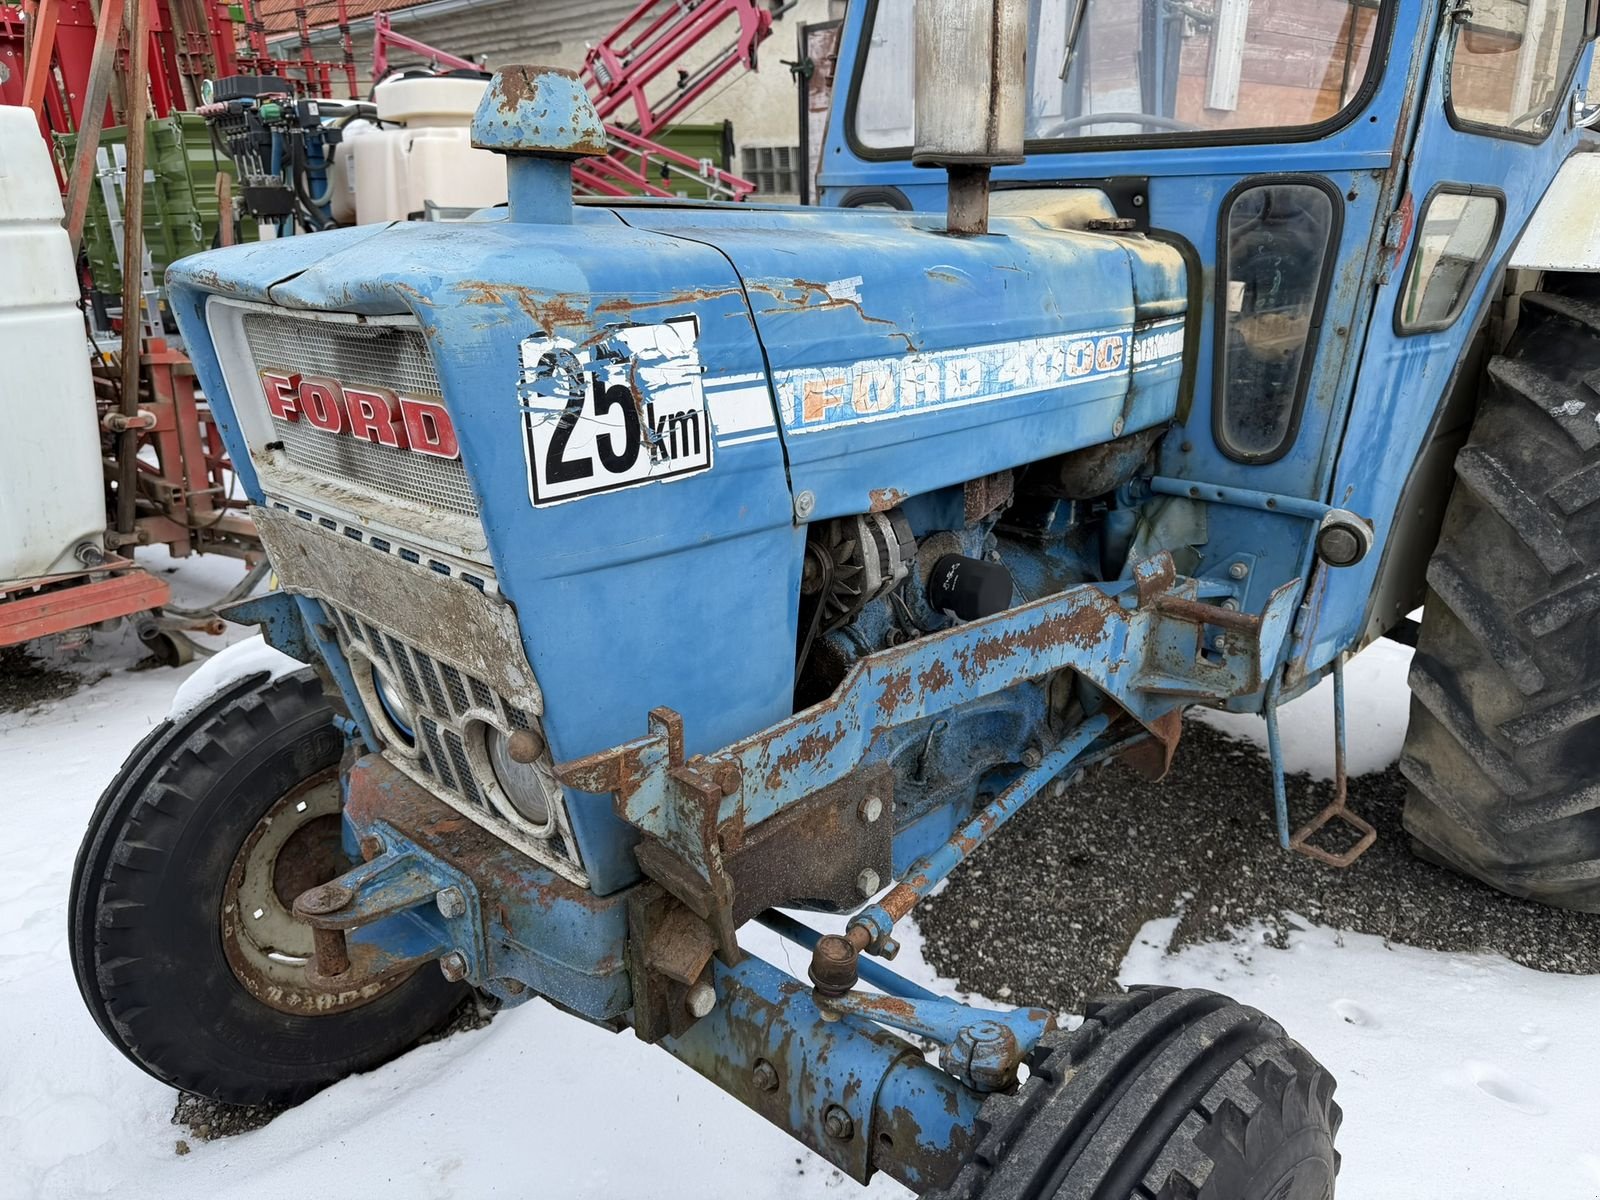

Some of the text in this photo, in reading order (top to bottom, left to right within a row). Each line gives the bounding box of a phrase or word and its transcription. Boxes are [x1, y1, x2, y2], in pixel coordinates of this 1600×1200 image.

[259, 367, 460, 460] FORD
[540, 341, 701, 485] 25 km
[802, 335, 1123, 424] FORD 4000
